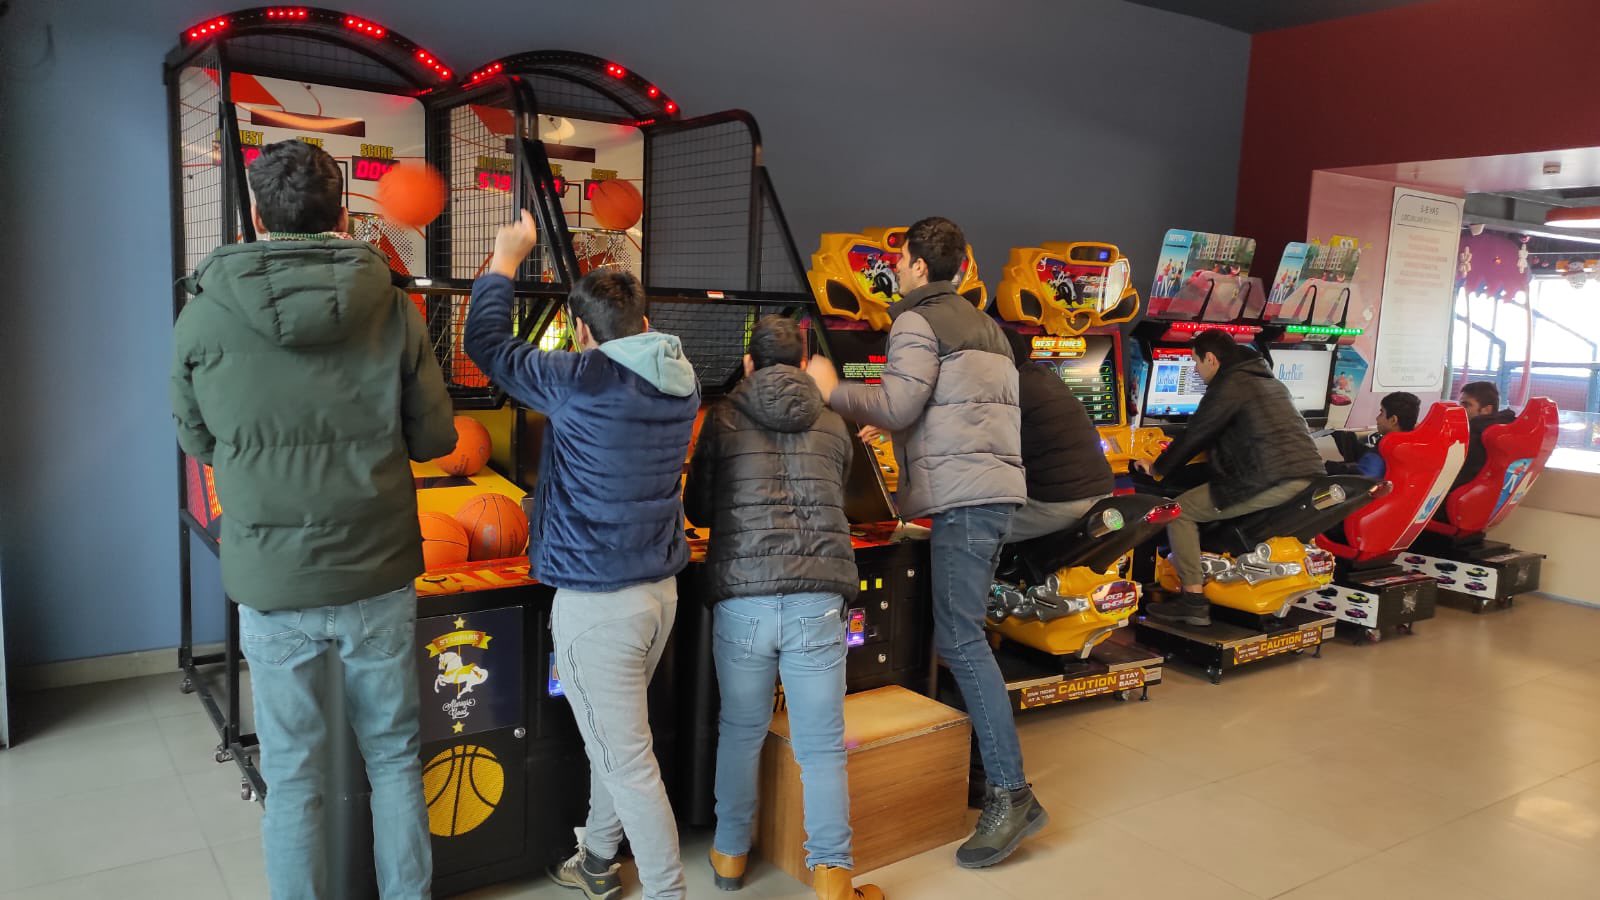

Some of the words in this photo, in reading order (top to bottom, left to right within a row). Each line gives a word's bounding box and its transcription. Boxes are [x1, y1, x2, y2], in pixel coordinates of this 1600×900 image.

[360, 143, 394, 159] SCORE
[1123, 591, 1136, 604] 2
[1260, 632, 1302, 651] CAUTION
[1119, 671, 1140, 680] STAY
[1058, 676, 1117, 694] CAUTION
[1118, 679, 1140, 687] BACK
